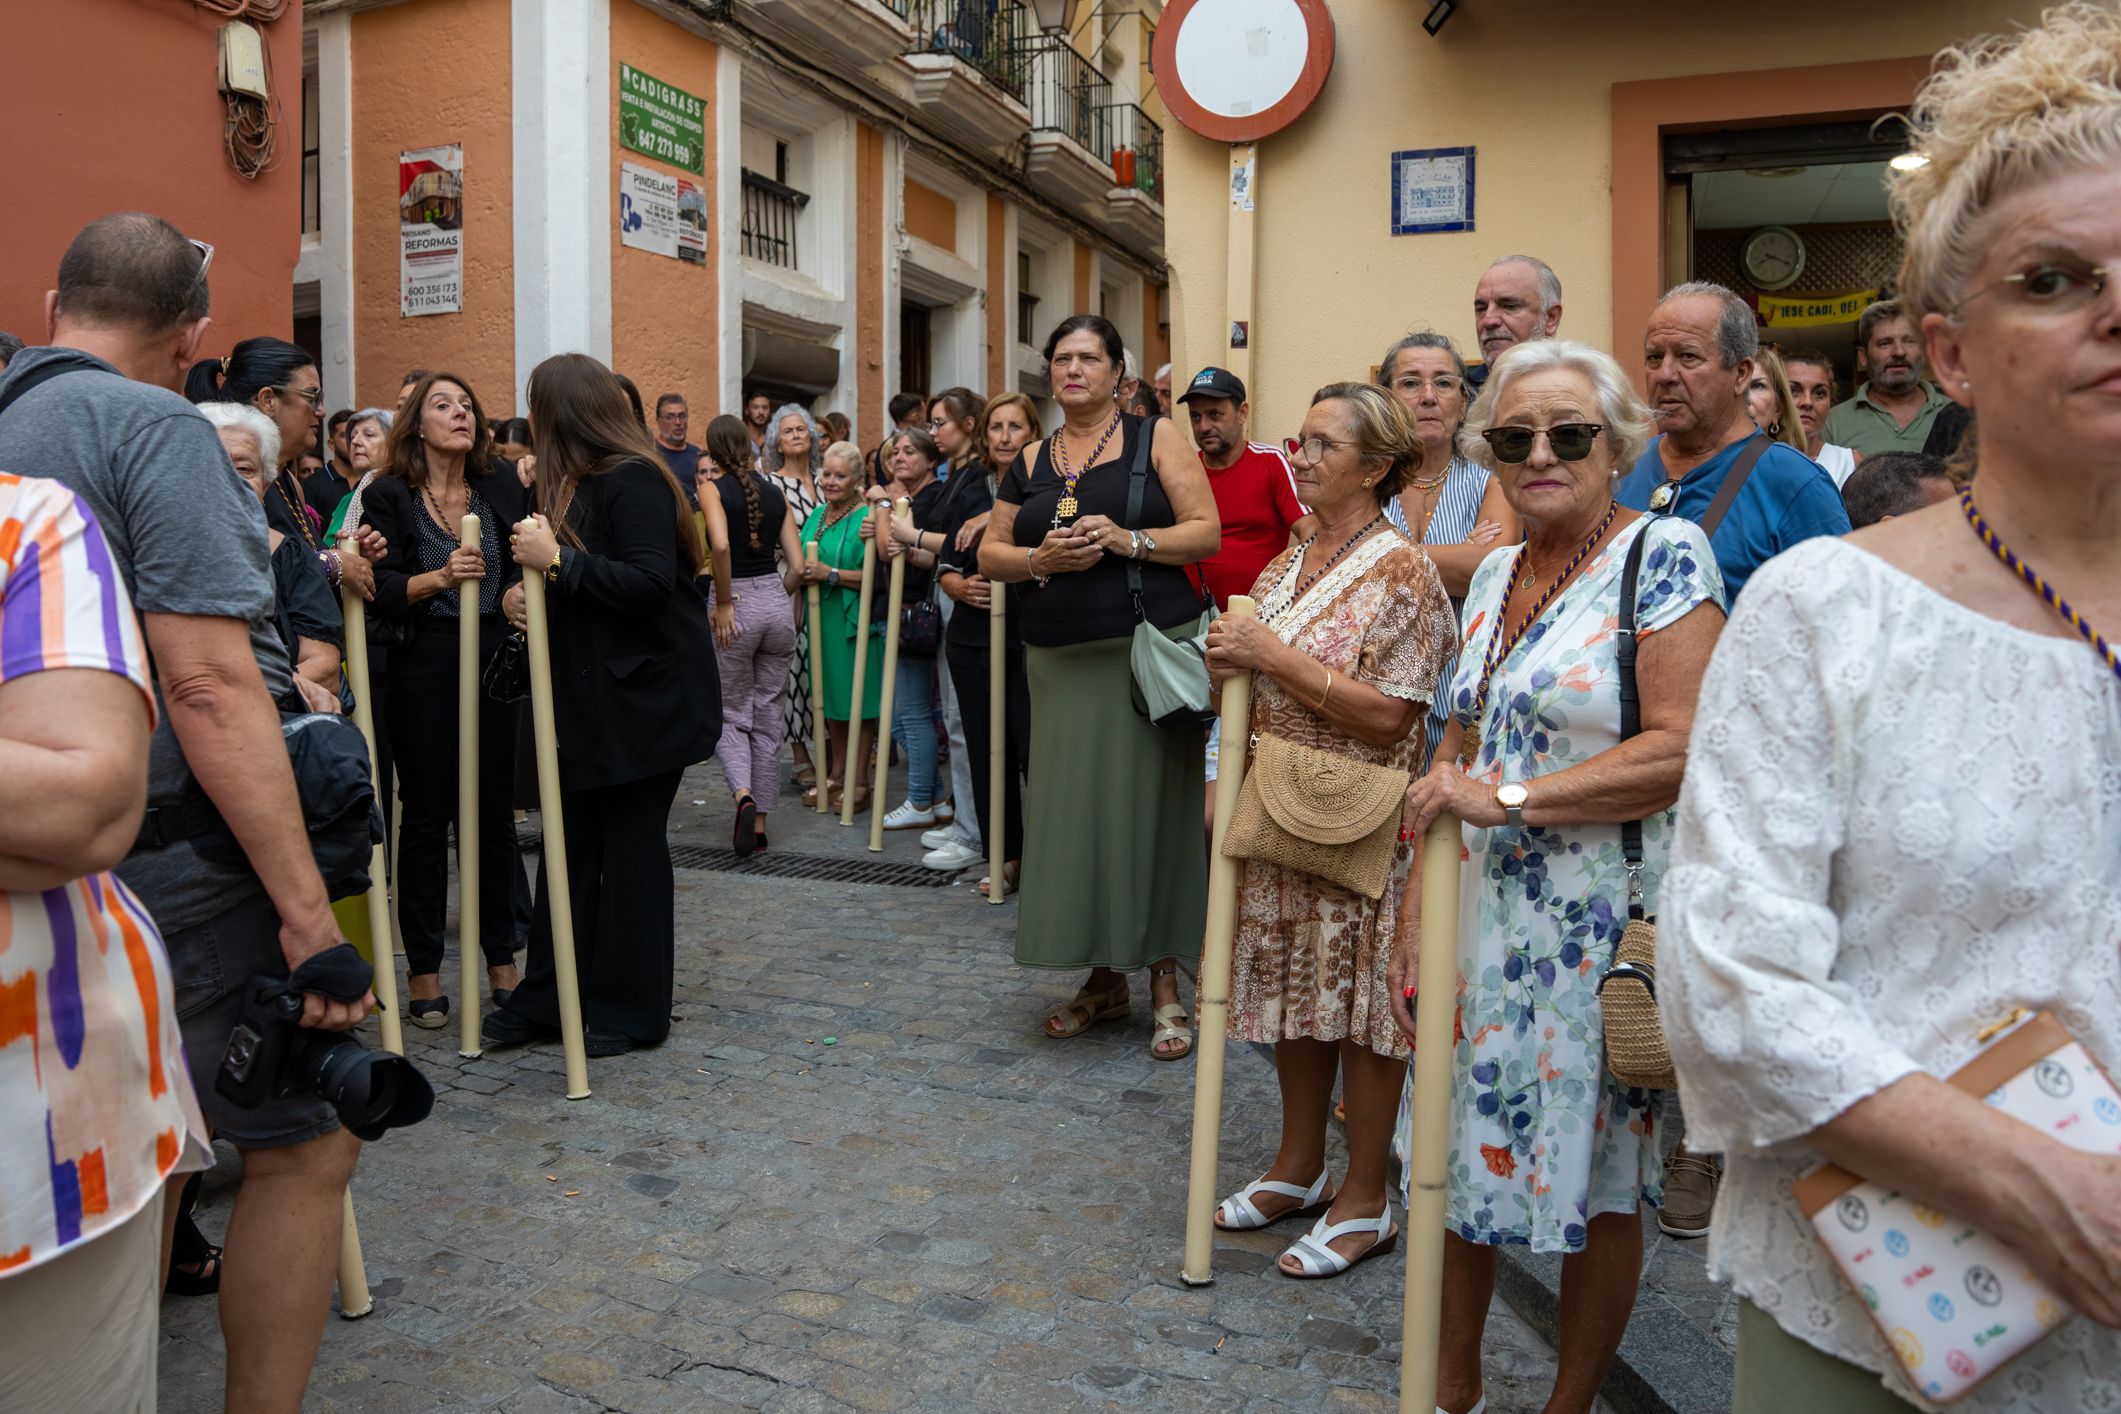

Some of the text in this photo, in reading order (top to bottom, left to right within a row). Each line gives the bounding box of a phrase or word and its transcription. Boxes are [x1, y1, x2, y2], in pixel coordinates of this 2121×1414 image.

[632, 73, 701, 117] CADIGRASS
[638, 128, 689, 165] 647 273 959
[405, 236, 458, 250] REFORMAS
[408, 286, 425, 296] 600
[408, 298, 424, 308] 611
[442, 294, 457, 304] 146
